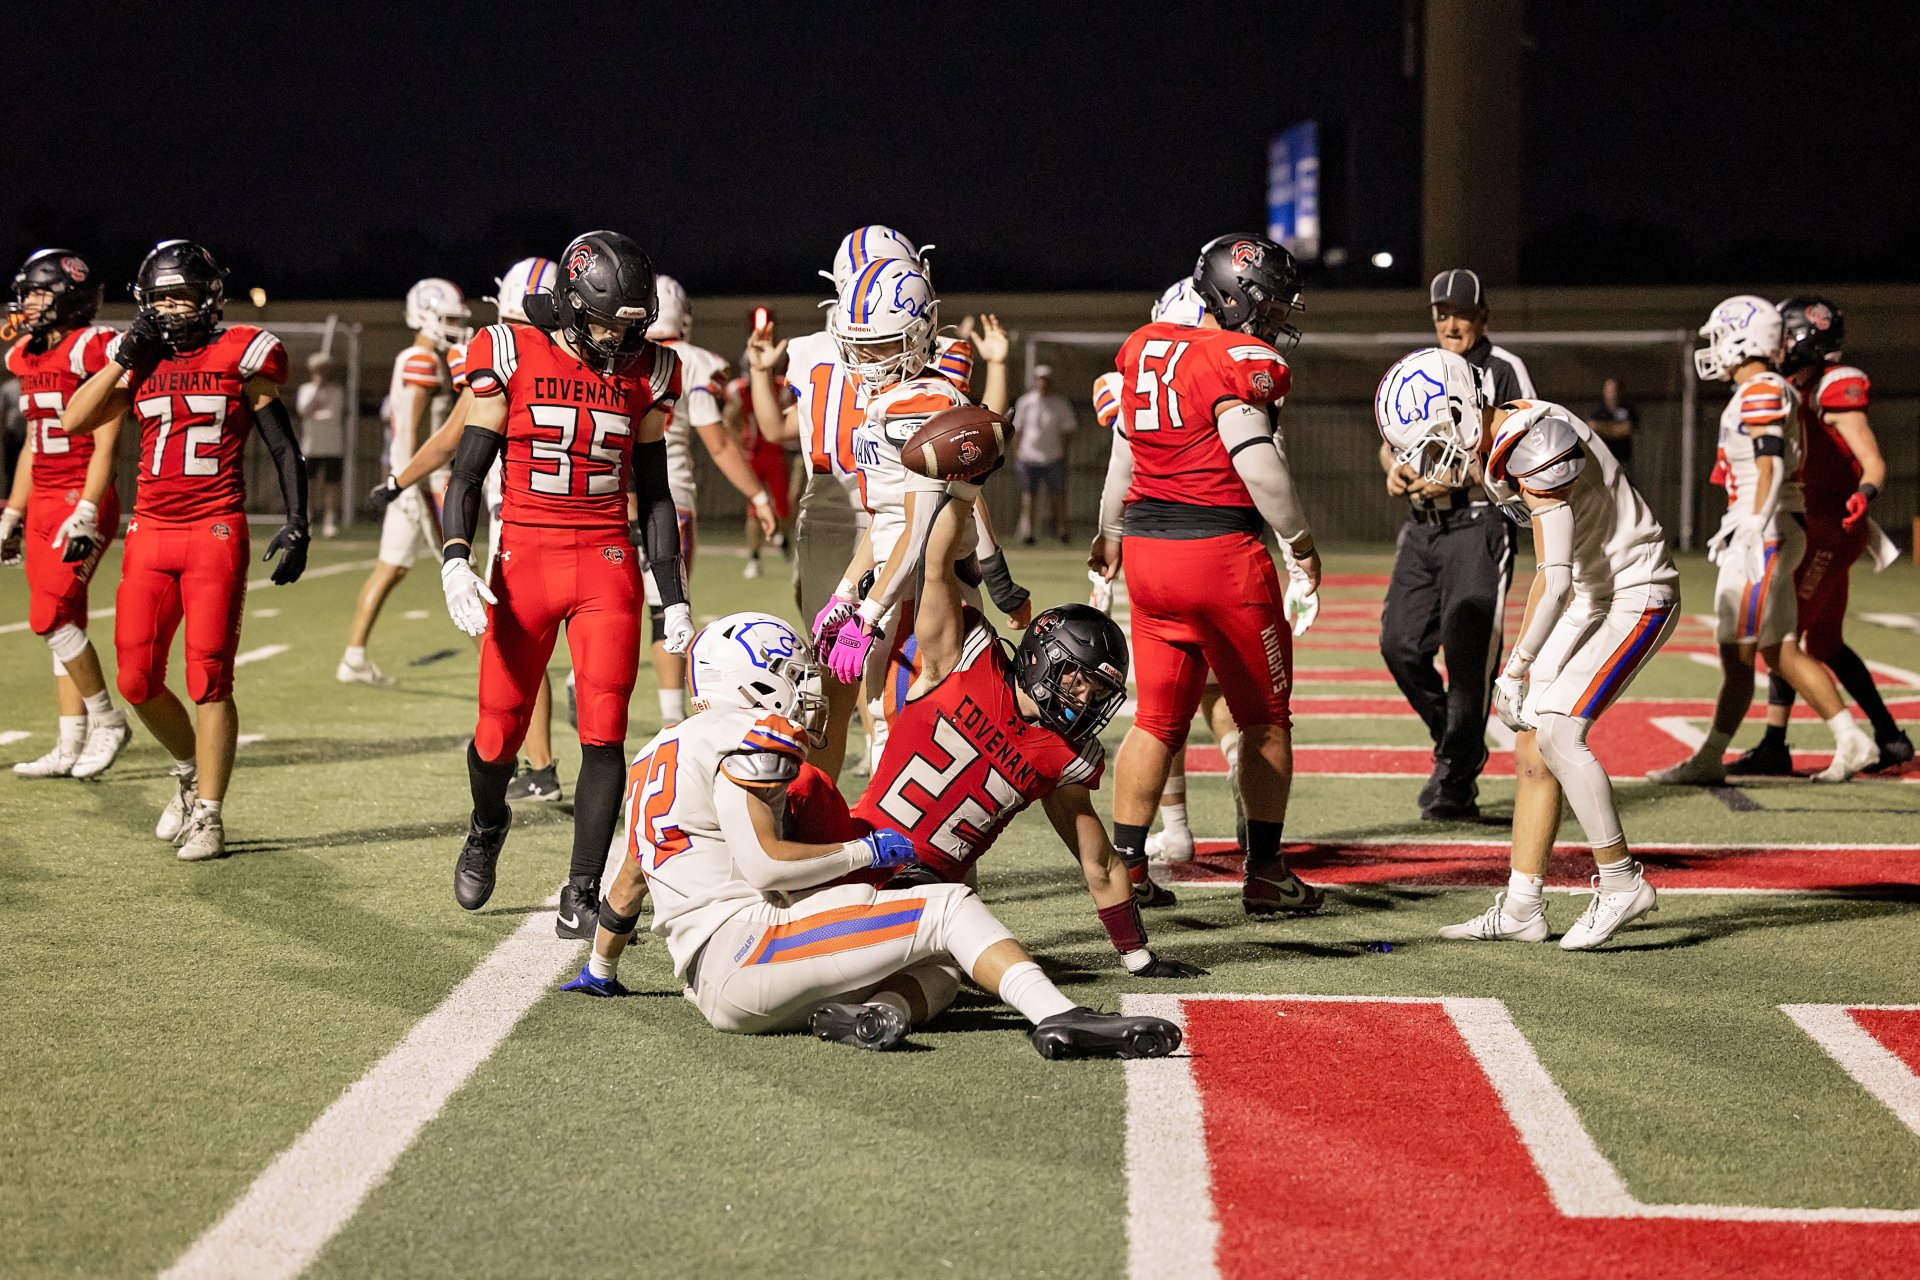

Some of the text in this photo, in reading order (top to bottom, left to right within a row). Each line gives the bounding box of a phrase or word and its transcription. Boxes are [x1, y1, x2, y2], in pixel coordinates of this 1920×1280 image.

[534, 377, 631, 410] COVENANT
[1134, 338, 1191, 433] 51
[136, 395, 228, 477] 72
[526, 403, 632, 497] 35
[1260, 623, 1288, 694] KNIGHTS
[875, 708, 1026, 864] 22
[953, 694, 1039, 791] COVENANT
[626, 737, 694, 871] 72
